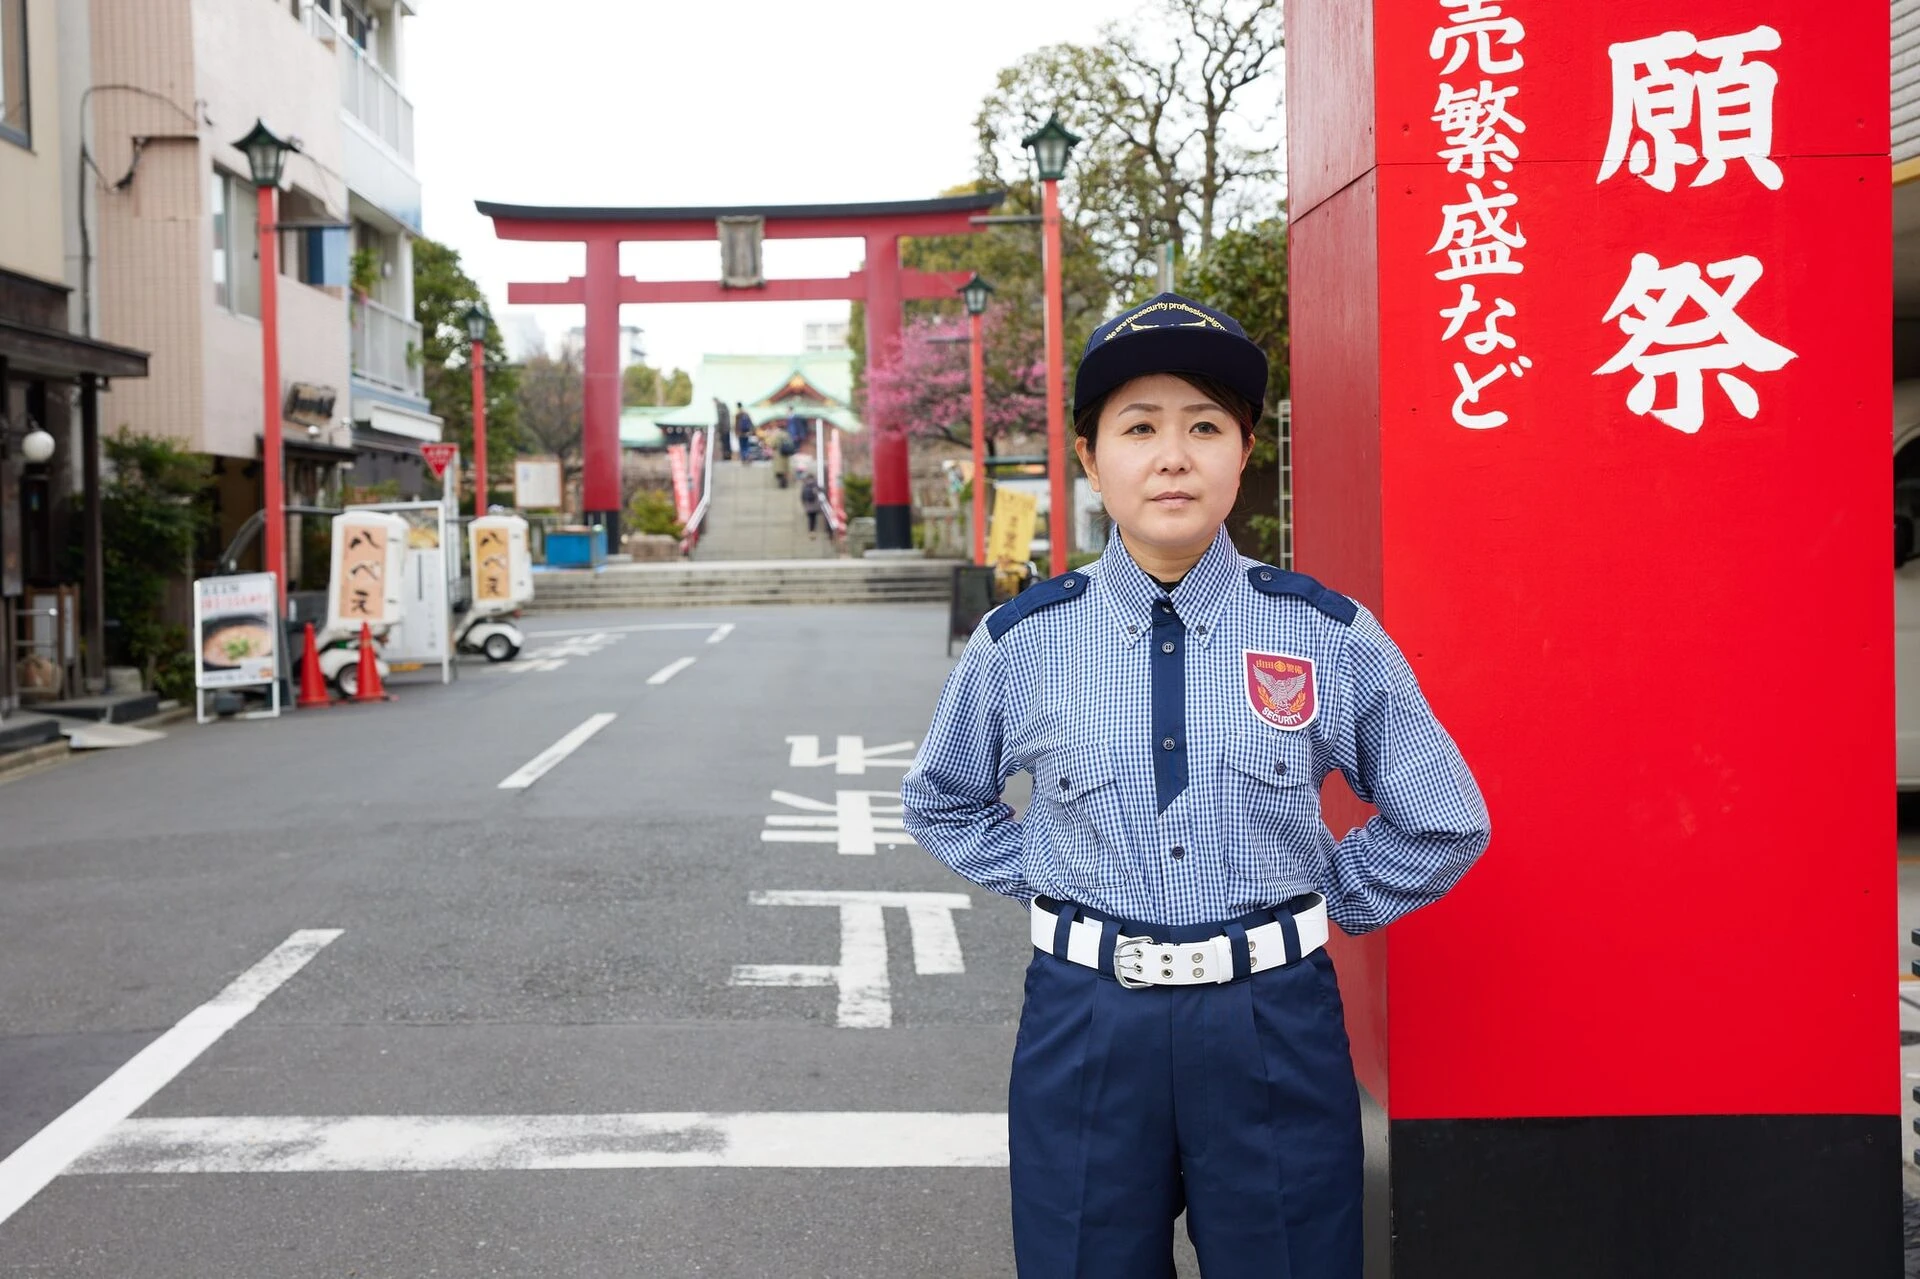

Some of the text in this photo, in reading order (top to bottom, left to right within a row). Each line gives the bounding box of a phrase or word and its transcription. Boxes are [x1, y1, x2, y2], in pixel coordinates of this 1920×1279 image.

[1115, 321, 1127, 333] are
[1126, 313, 1138, 325] the
[1138, 301, 1169, 317] security
[1168, 302, 1215, 323] professional
[1427, 0, 1533, 430] 売繁盛など
[1592, 25, 1799, 434] 願祭
[1261, 707, 1303, 725] SECURITY
